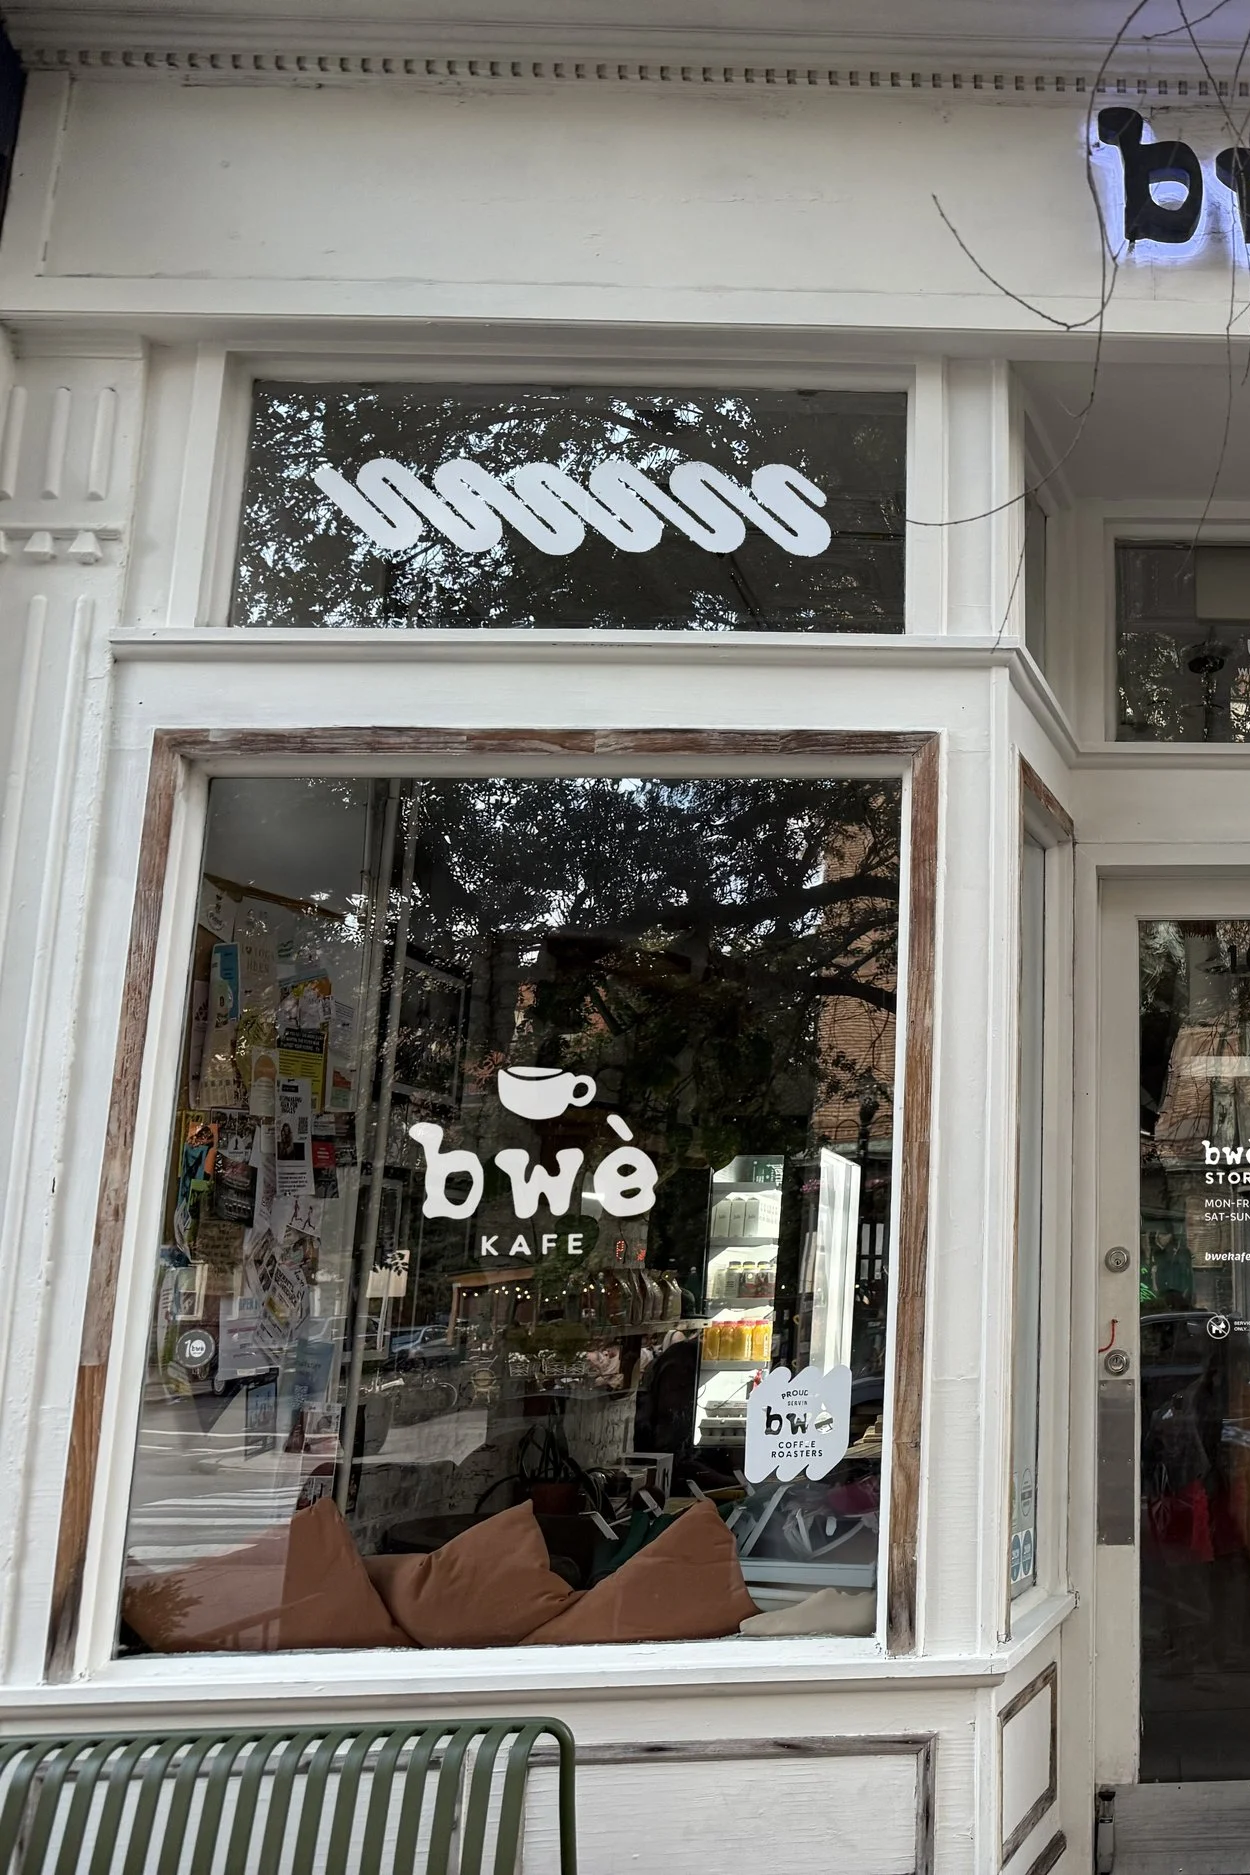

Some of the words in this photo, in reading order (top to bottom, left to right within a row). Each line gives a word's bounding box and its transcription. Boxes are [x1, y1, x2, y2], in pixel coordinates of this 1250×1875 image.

[408, 1114, 658, 1219] bwè
[480, 1233, 584, 1256] KAFE
[771, 1450, 823, 1458] ROASTERS
